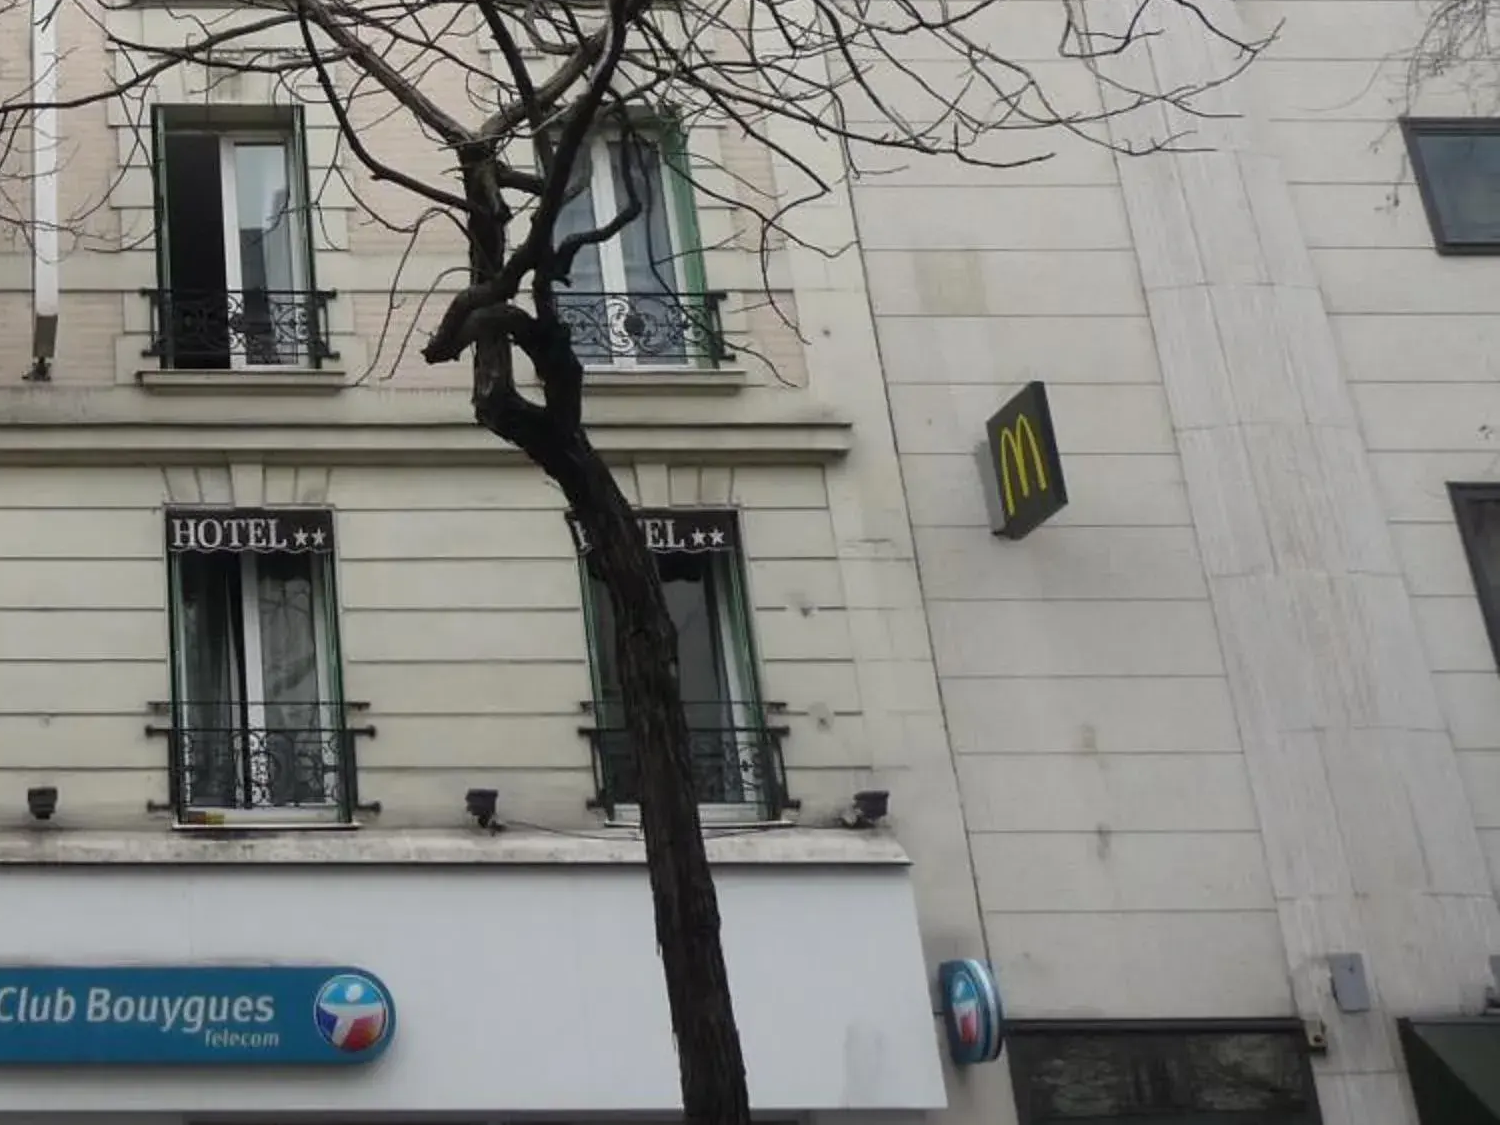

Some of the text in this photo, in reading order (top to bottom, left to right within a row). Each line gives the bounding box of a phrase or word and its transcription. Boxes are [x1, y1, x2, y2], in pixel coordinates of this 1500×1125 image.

[172, 518, 287, 548] HOTEL
[86, 988, 274, 1033] Bouygues
[205, 1028, 280, 1048] Telecom
